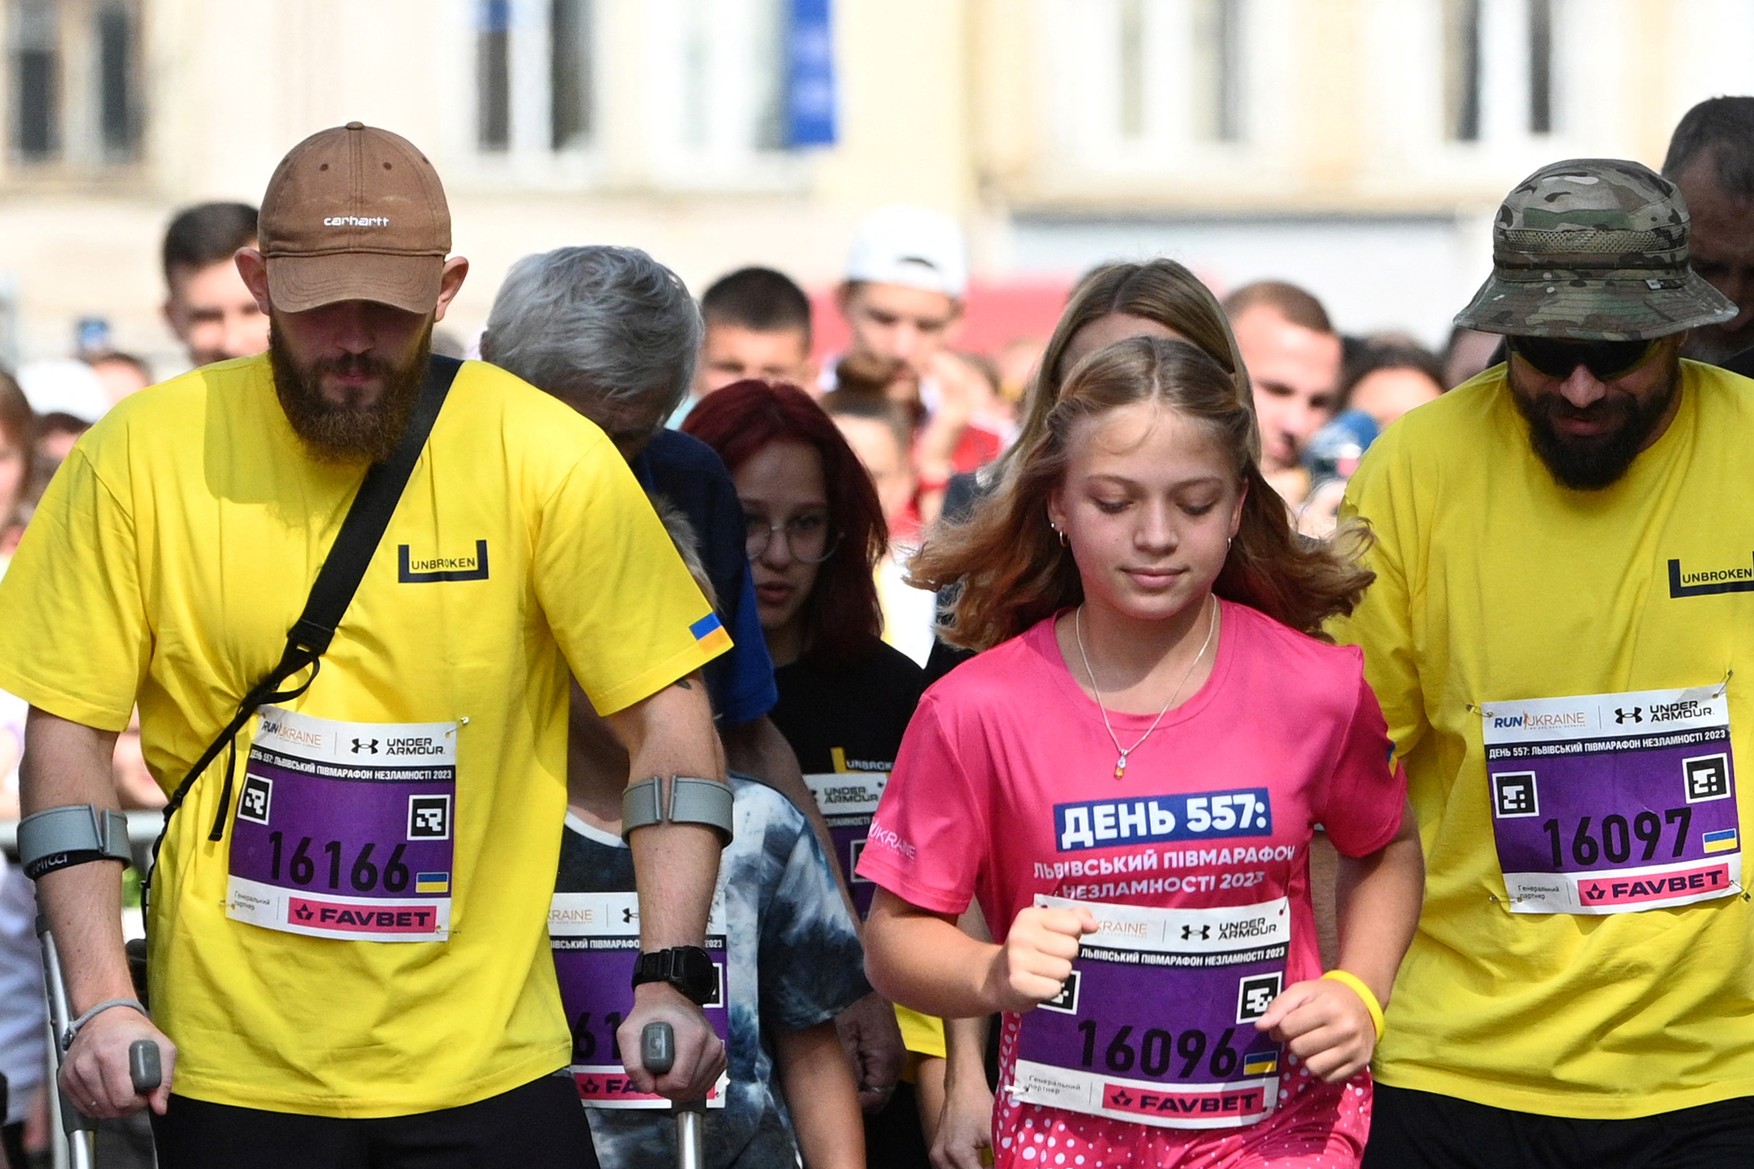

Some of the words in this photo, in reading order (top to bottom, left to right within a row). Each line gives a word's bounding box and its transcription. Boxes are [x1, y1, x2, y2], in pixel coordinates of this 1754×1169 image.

[323, 215, 390, 228] carhartt
[411, 557, 476, 570] UNBROKEN
[1681, 567, 1754, 585] UNBROKEN
[1650, 700, 1699, 714] UNDER
[1494, 717, 1524, 729] RUN
[1650, 709, 1713, 723] ARMOUR
[386, 744, 444, 755] ARMOUR
[387, 737, 433, 747] UNDER
[1489, 746, 1512, 760] ДЕНЬ
[1512, 746, 1530, 758] 557:
[1531, 740, 1584, 757] ЛЬВІВСЬКИЙ
[1584, 737, 1641, 753] ПІВМАРАФОН
[1642, 732, 1703, 750] НЕЗЛАМНОСТІ
[1704, 729, 1727, 742] 2023
[316, 765, 373, 780] ПІВМАРАФОН
[374, 769, 432, 780] НЕЗЛАМНОСТІ
[433, 769, 452, 780] 2023
[845, 759, 893, 771] UNBROK
[824, 787, 866, 795] UNDER
[824, 794, 879, 803] ARMOUR
[826, 817, 871, 828] ЗЛАМНОСТІ
[1061, 804, 1176, 850] ДЕНЬ
[1186, 793, 1268, 830] 557:
[1543, 806, 1693, 870] 16097
[268, 830, 410, 893] 16166
[1033, 848, 1159, 880] ЛЬВІВСЬКИЙ
[1162, 845, 1296, 869] ПІВМАРАФОН
[1062, 876, 1216, 899] НЕЗЛАМНОСТІ
[1220, 870, 1266, 889] 2023
[1612, 869, 1724, 899] FAVBET
[319, 908, 431, 928] FAVBET
[547, 909, 593, 921] KRAINE
[1099, 921, 1148, 935] RAINE
[1219, 917, 1267, 932] UNDER
[1218, 925, 1277, 940] ARMOUR
[551, 938, 588, 949] ІВСЬКИЙ
[589, 941, 640, 949] ПІВМАРАФО
[1081, 948, 1140, 964] ЛЬВІВСЬКИЙ
[1140, 954, 1204, 966] ПІВМАРАФОН
[1204, 950, 1264, 966] НЕЗЛАМНОСТІ
[1265, 946, 1285, 960] 2023
[1078, 1019, 1238, 1079] 16096
[1139, 1093, 1259, 1113] FAVBET
